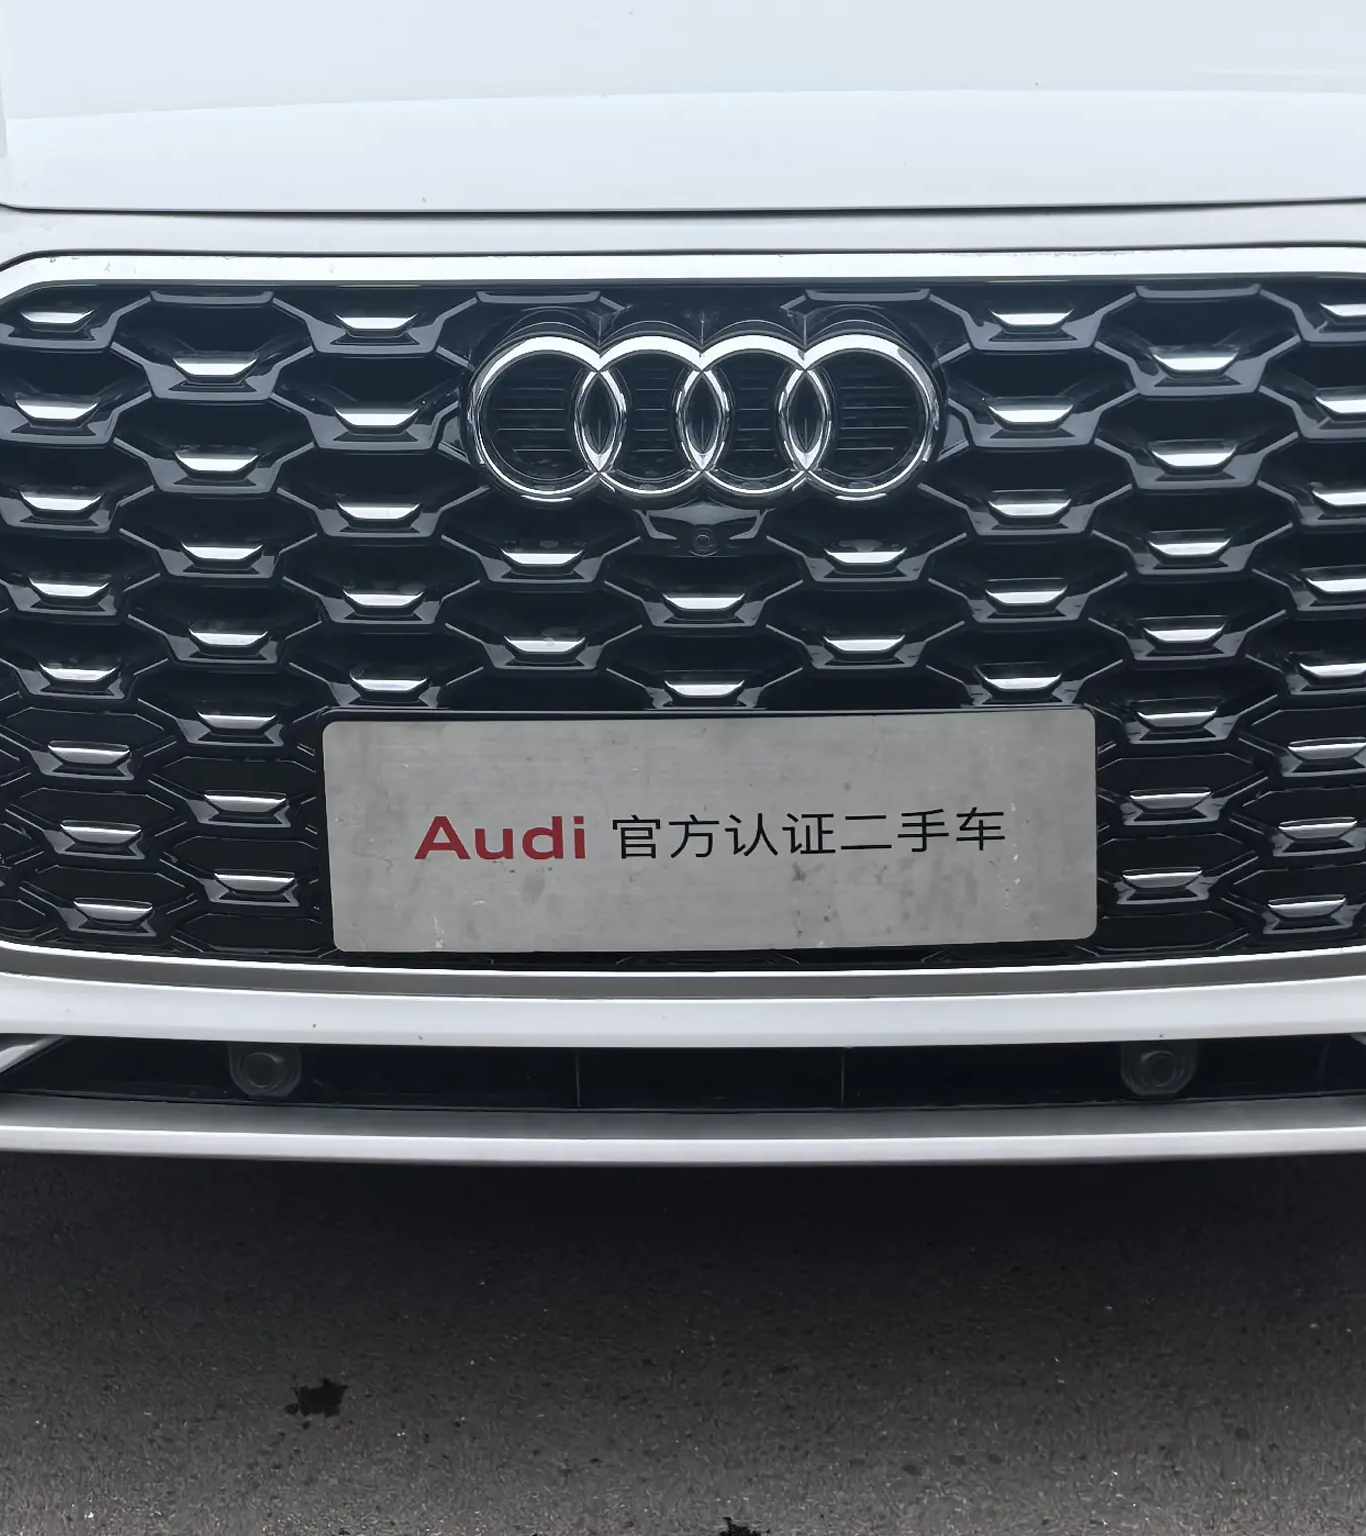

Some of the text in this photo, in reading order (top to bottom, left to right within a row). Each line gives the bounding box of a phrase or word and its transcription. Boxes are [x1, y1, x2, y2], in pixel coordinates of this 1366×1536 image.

[414, 806, 1007, 861] Audi 官方认证二手车
